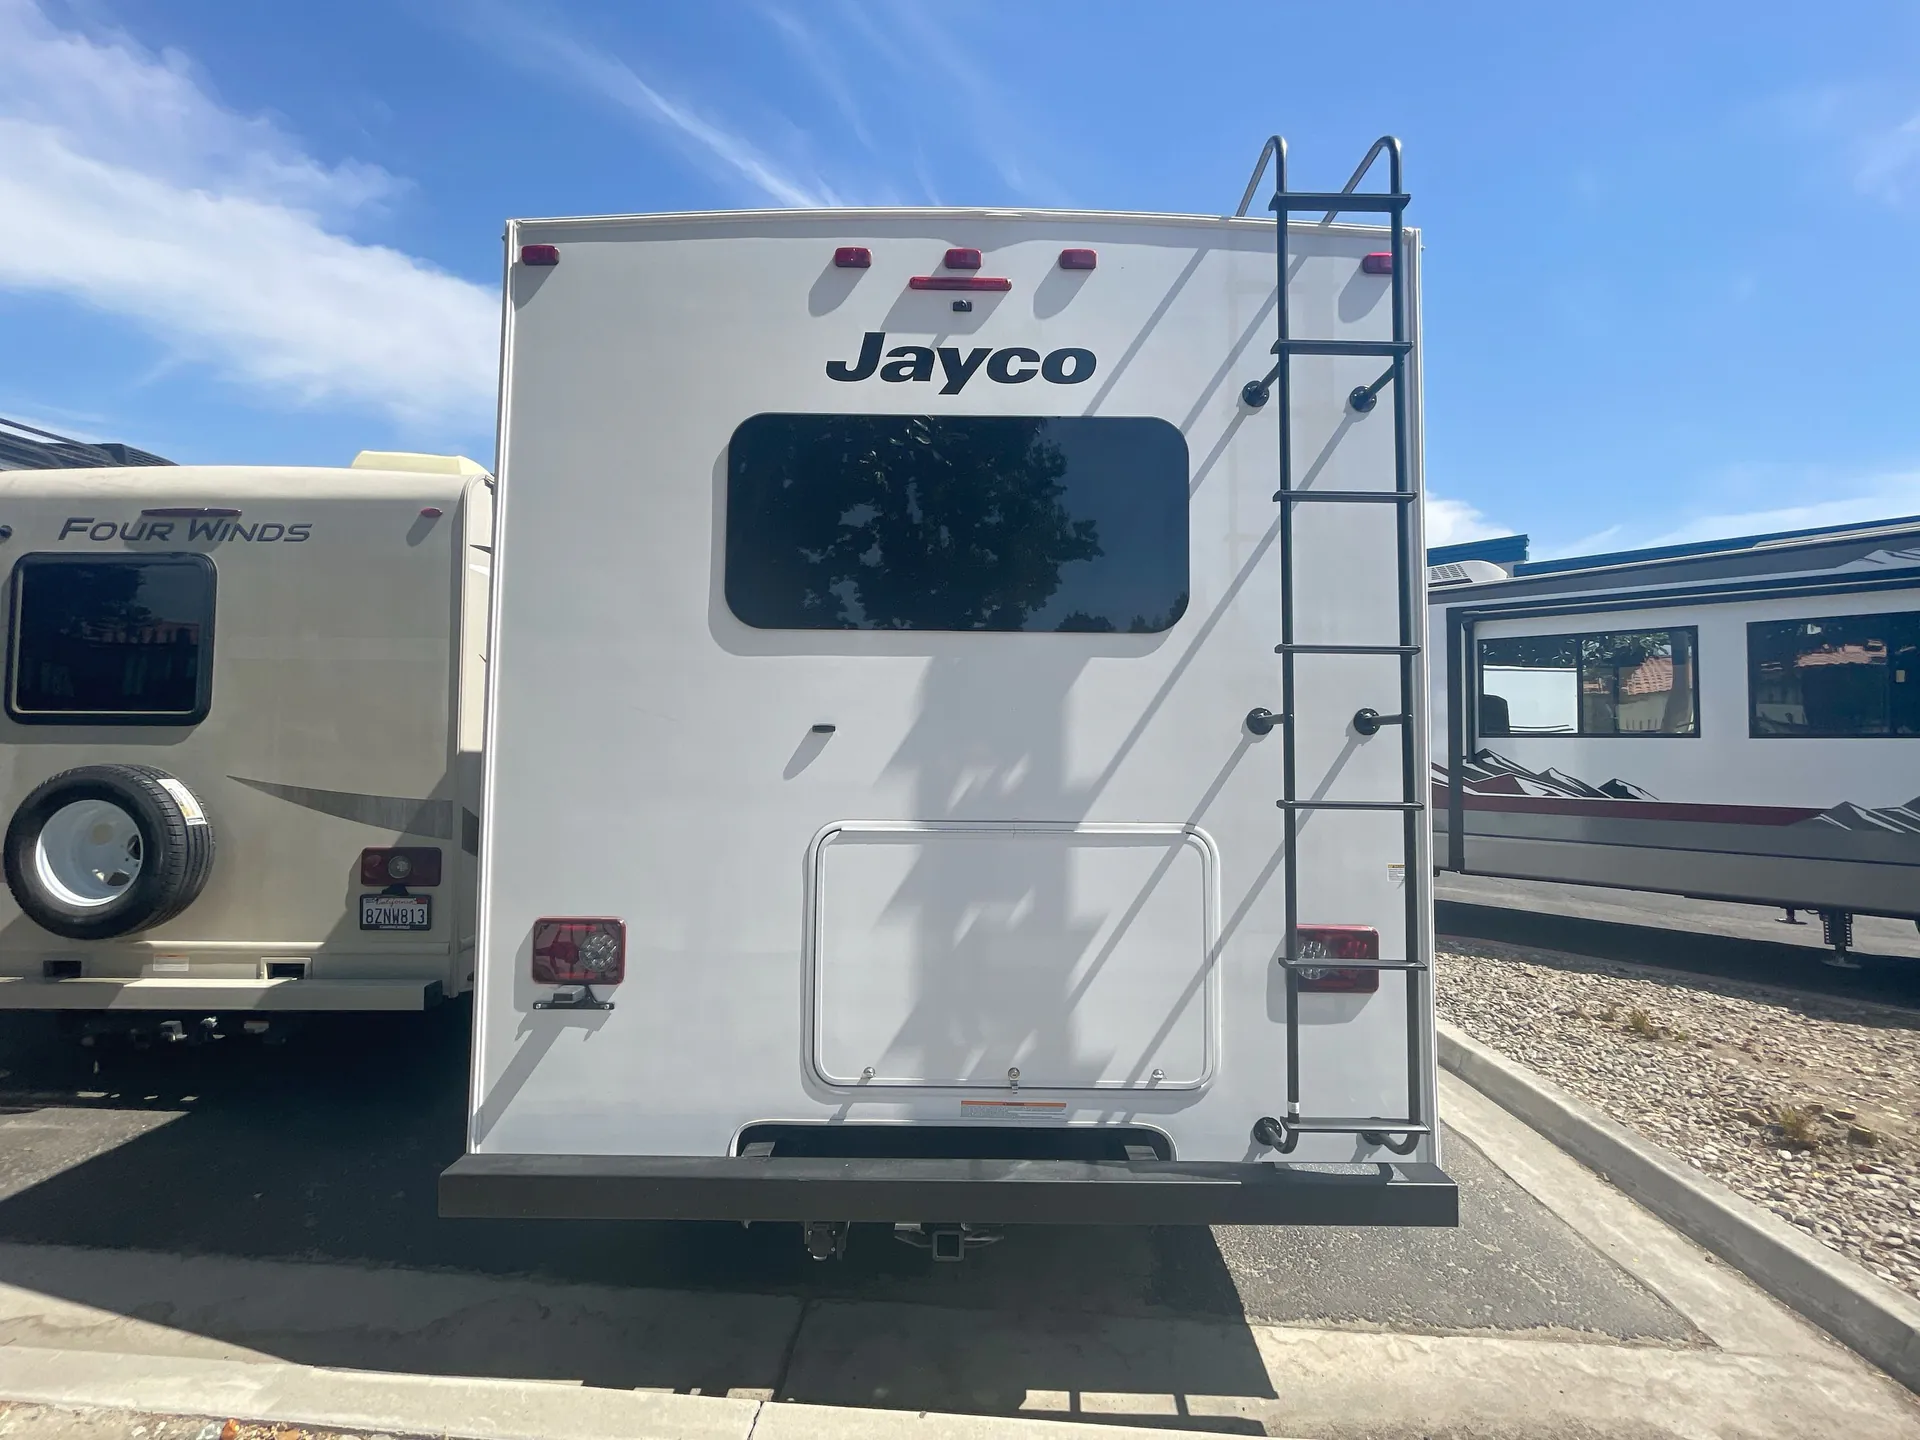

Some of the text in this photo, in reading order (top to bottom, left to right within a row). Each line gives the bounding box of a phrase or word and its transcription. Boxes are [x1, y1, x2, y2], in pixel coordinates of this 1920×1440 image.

[826, 332, 1097, 395] Jayco
[58, 517, 313, 542] FOUR WINDS
[365, 908, 425, 924] 8ZNW813
